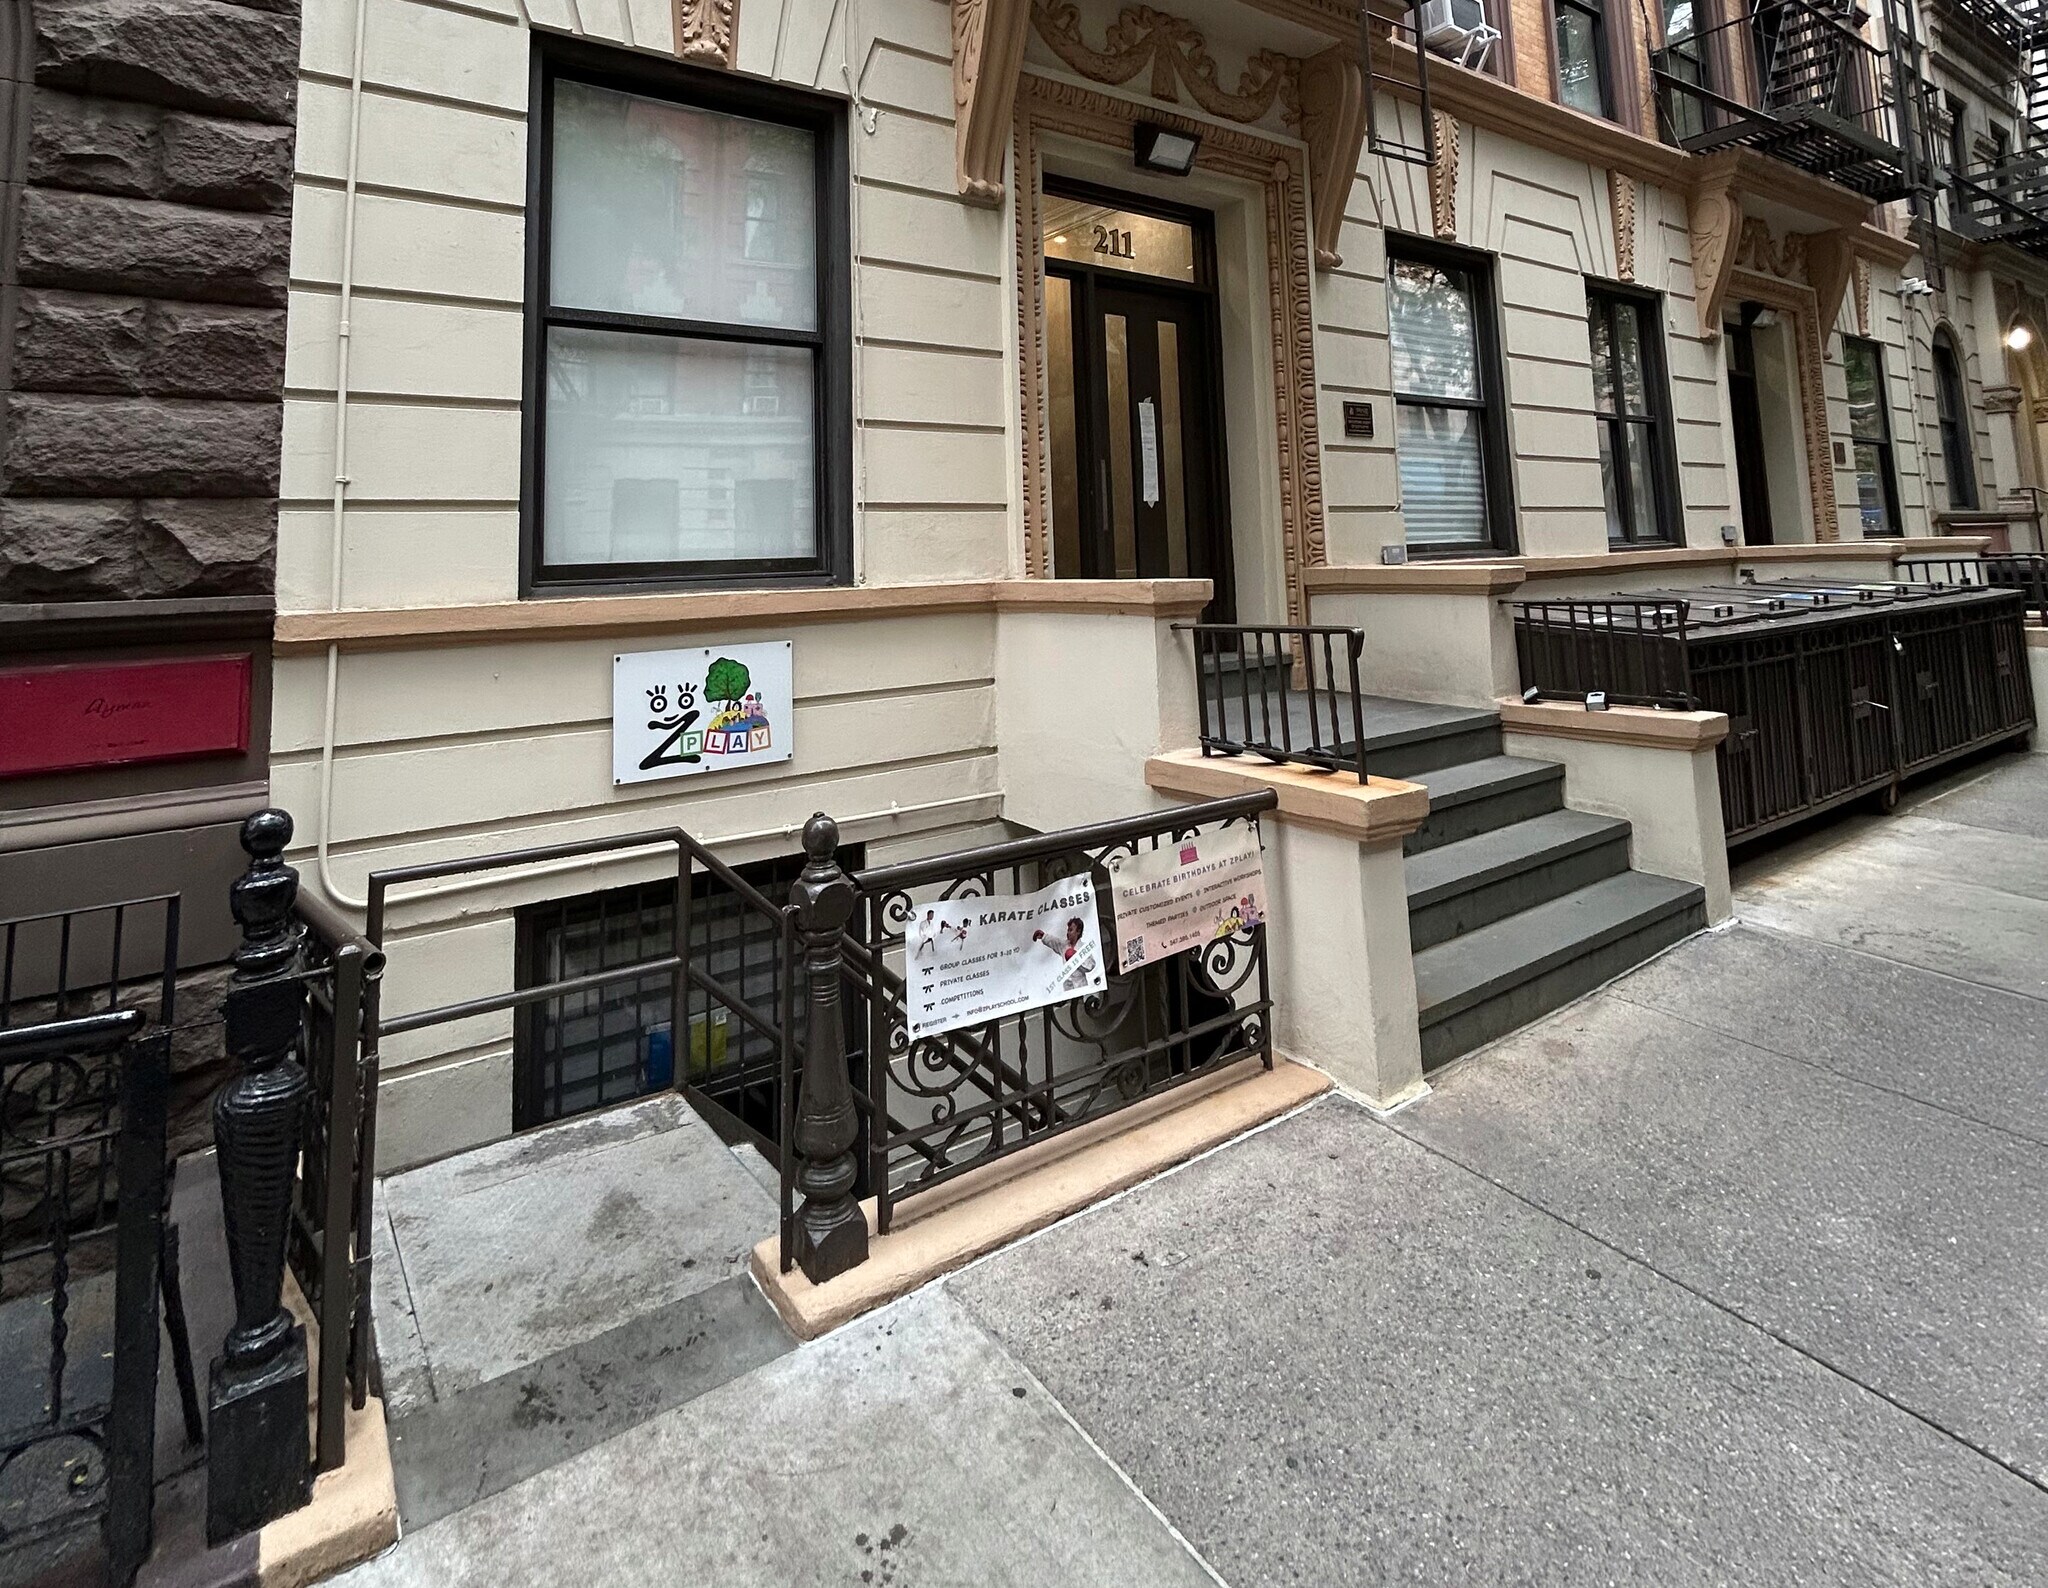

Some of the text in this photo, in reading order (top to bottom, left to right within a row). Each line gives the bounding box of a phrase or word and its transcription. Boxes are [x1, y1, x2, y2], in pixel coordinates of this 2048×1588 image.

[1094, 225, 1134, 259] 211
[1122, 878, 1171, 898] CELEBRATE
[1173, 864, 1216, 884] BIRTHDAYS
[1219, 859, 1227, 869] AT
[1203, 869, 1262, 894] INTERACTIVE WORKSHOPS
[979, 892, 1090, 926] KARATE CLASSES
[1117, 892, 1193, 920] PRIVATE CUSTOMIZED EVENTS
[1168, 911, 1189, 921] PARTIES
[939, 961, 960, 971] GROUP
[961, 955, 986, 966] CLASSES
[987, 952, 998, 960] FOR
[940, 970, 990, 988] PRIVATE CLASSES
[1046, 981, 1056, 994] 1ST
[1056, 966, 1071, 982] CLASS
[1072, 958, 1079, 966] IS
[941, 988, 984, 1006] COMPETITIONS
[922, 1016, 947, 1028] REGISTER
